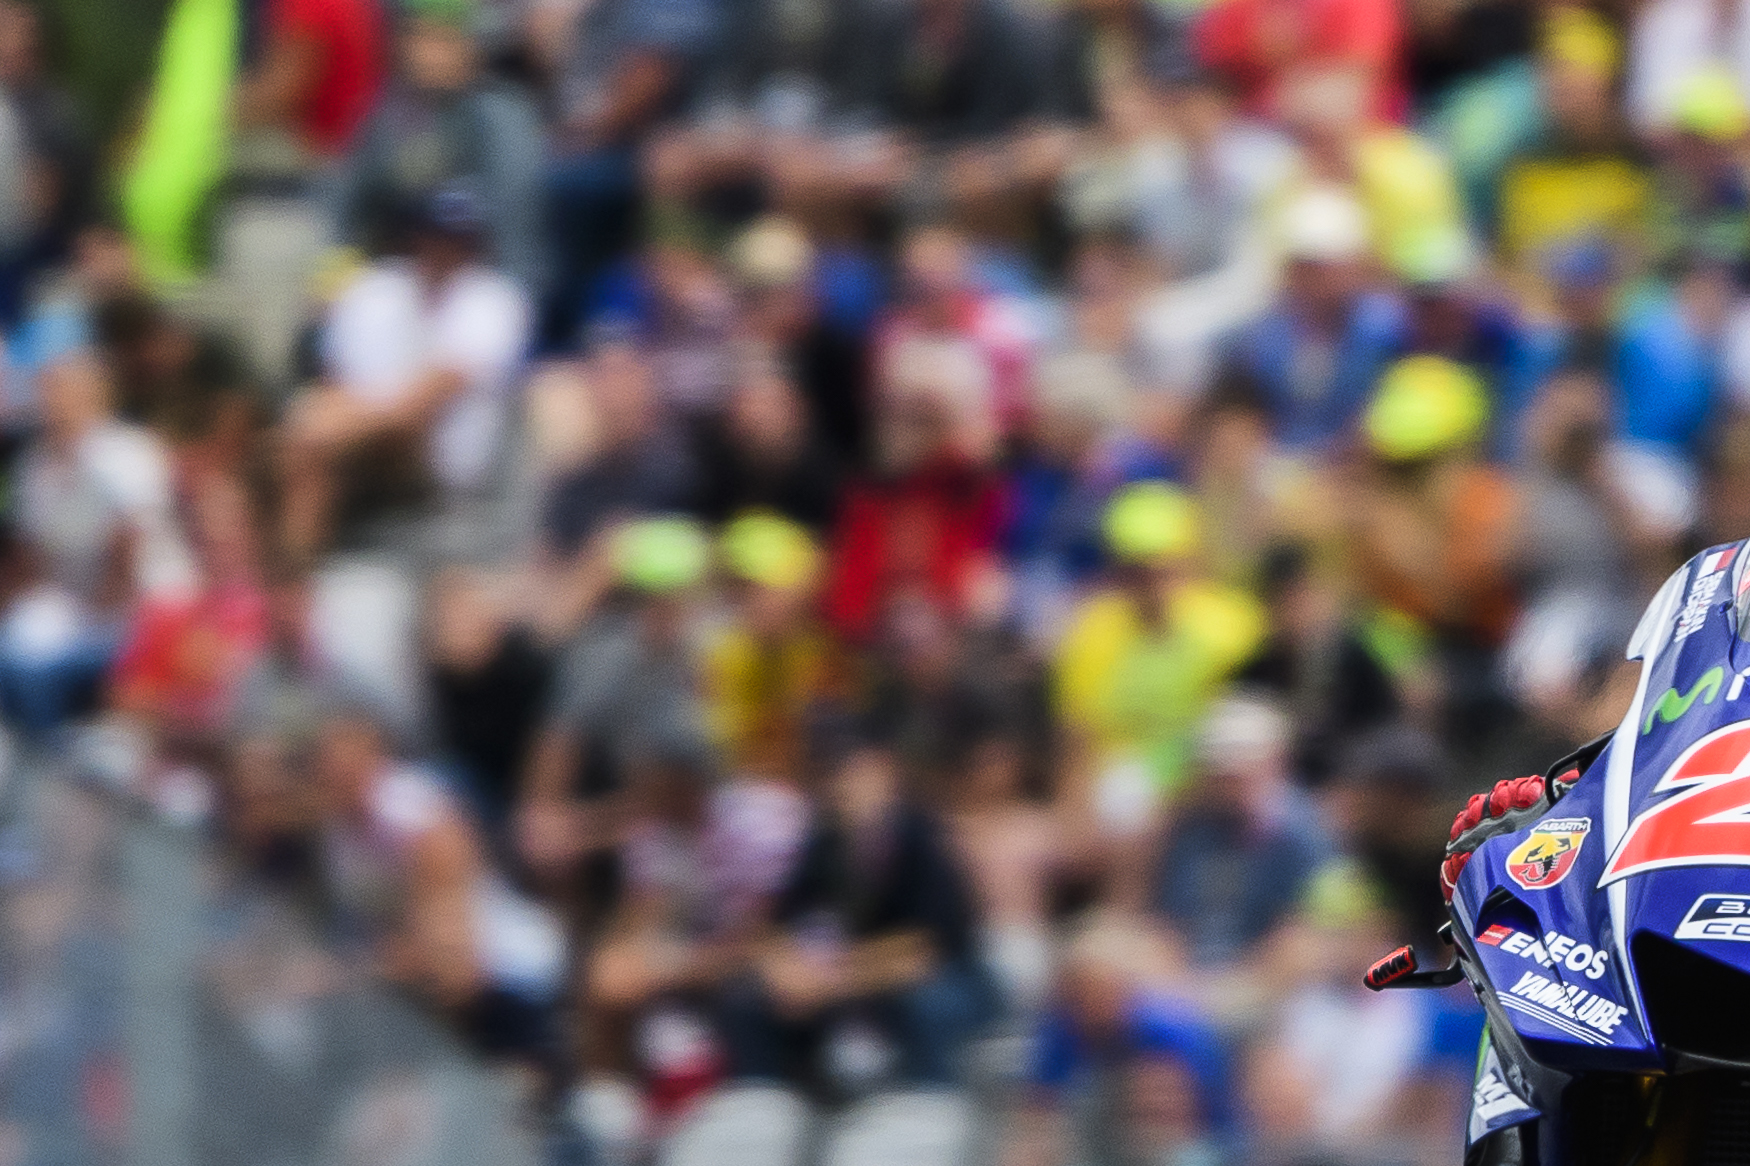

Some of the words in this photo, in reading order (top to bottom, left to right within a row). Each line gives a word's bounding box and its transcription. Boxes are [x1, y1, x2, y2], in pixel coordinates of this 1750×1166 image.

[1537, 823, 1588, 832] ABARTH
[1500, 931, 1609, 980] ENEOS
[1509, 970, 1629, 1035] YAMALUBE
